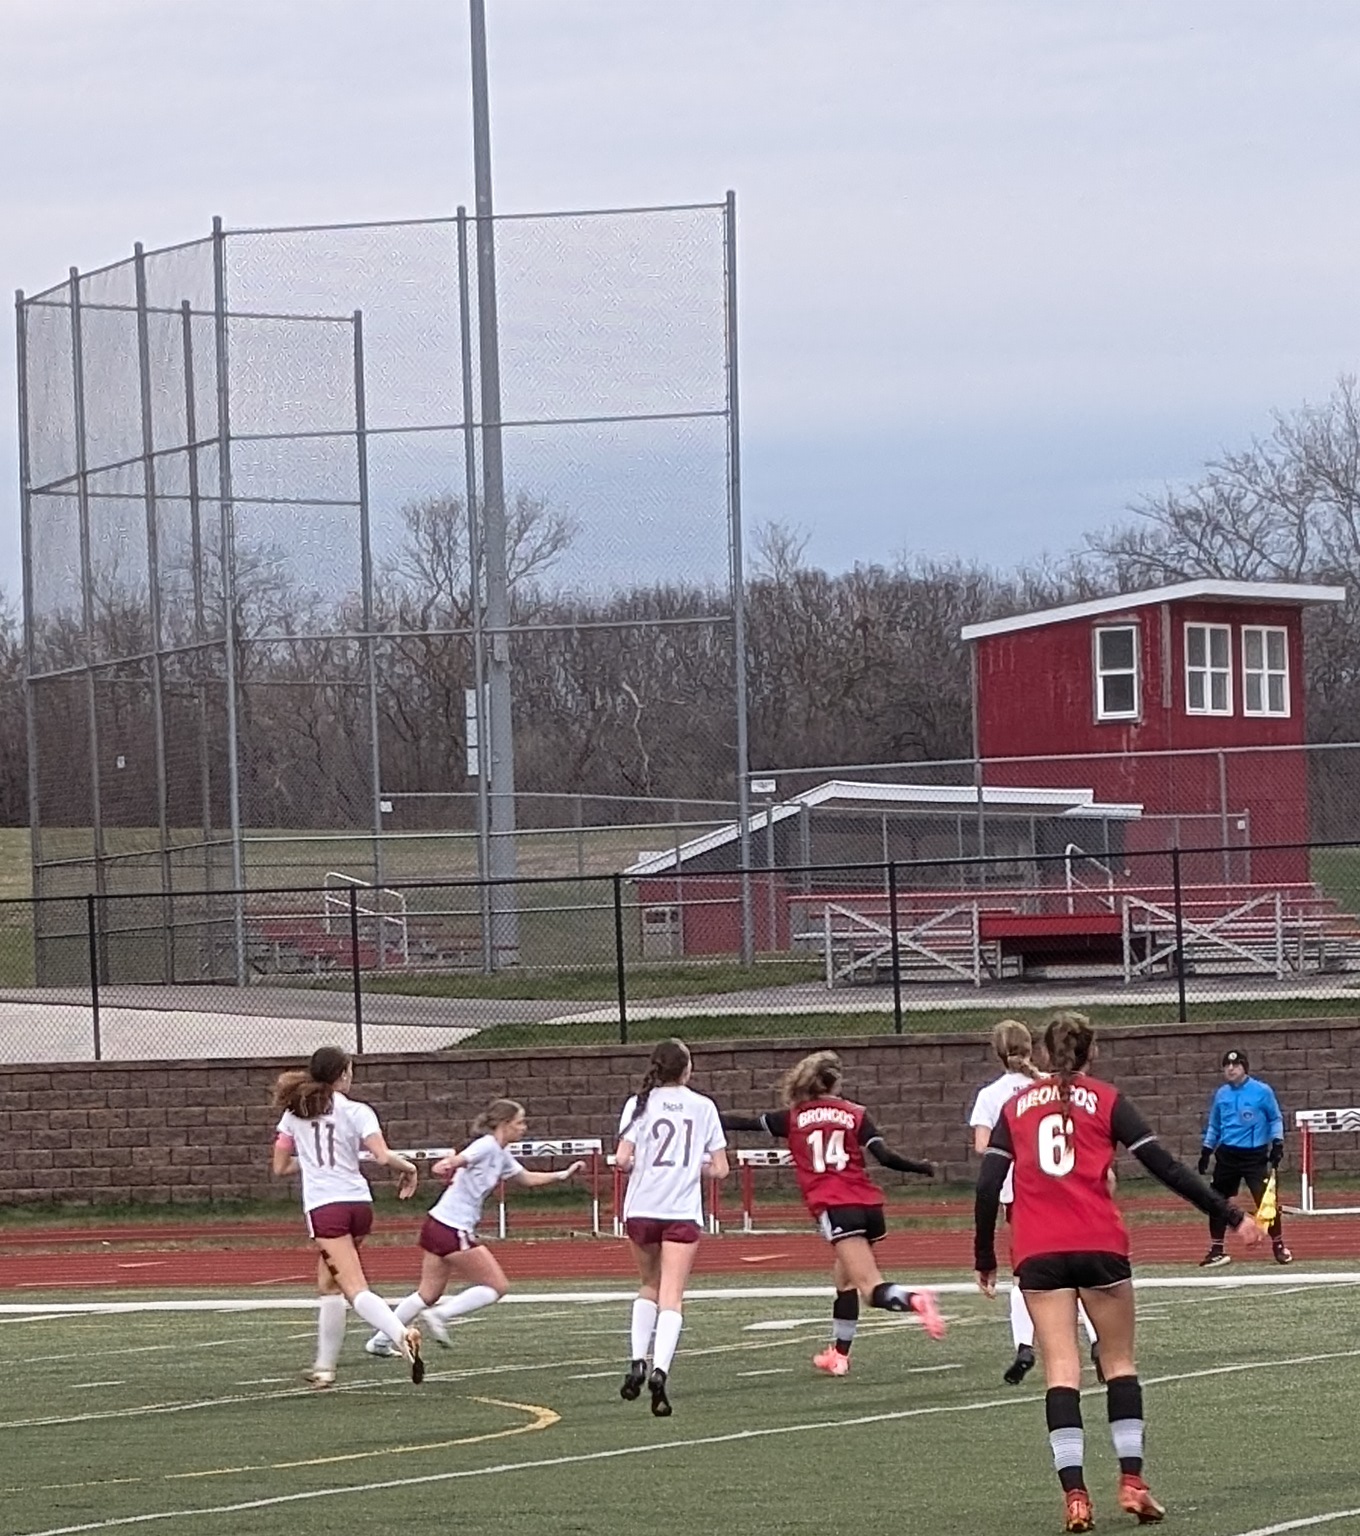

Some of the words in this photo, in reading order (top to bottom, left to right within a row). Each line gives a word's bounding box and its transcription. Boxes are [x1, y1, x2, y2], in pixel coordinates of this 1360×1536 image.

[797, 1107, 856, 1129] BRONCOS
[311, 1121, 335, 1169] 11
[652, 1118, 693, 1167] 21
[806, 1130, 850, 1173] 14
[1039, 1113, 1075, 1176] 6
